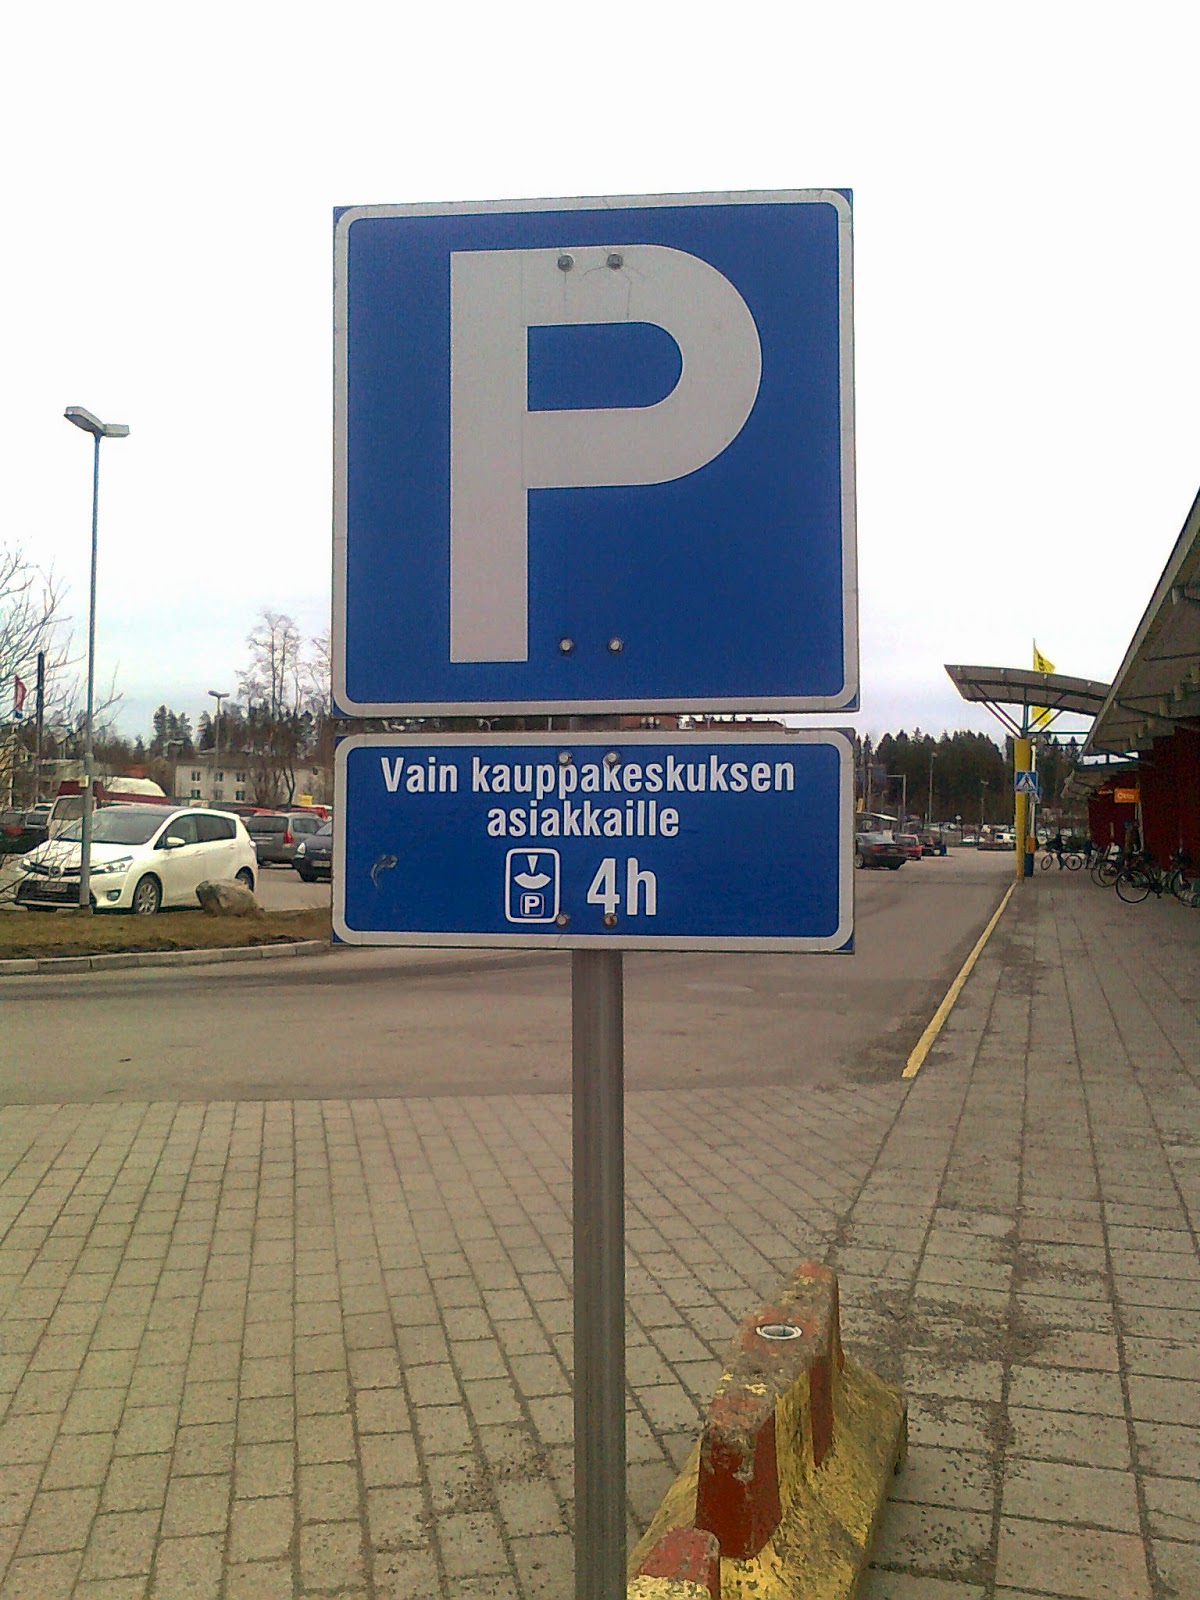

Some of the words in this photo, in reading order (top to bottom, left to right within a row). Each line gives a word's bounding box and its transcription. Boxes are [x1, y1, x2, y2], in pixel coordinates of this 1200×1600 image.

[450, 244, 762, 663] P
[381, 756, 458, 793] Vain
[472, 755, 794, 800] kauppakeskuksen
[487, 800, 679, 837] asiakkaille
[524, 895, 540, 914] P
[587, 857, 657, 916] 4h
